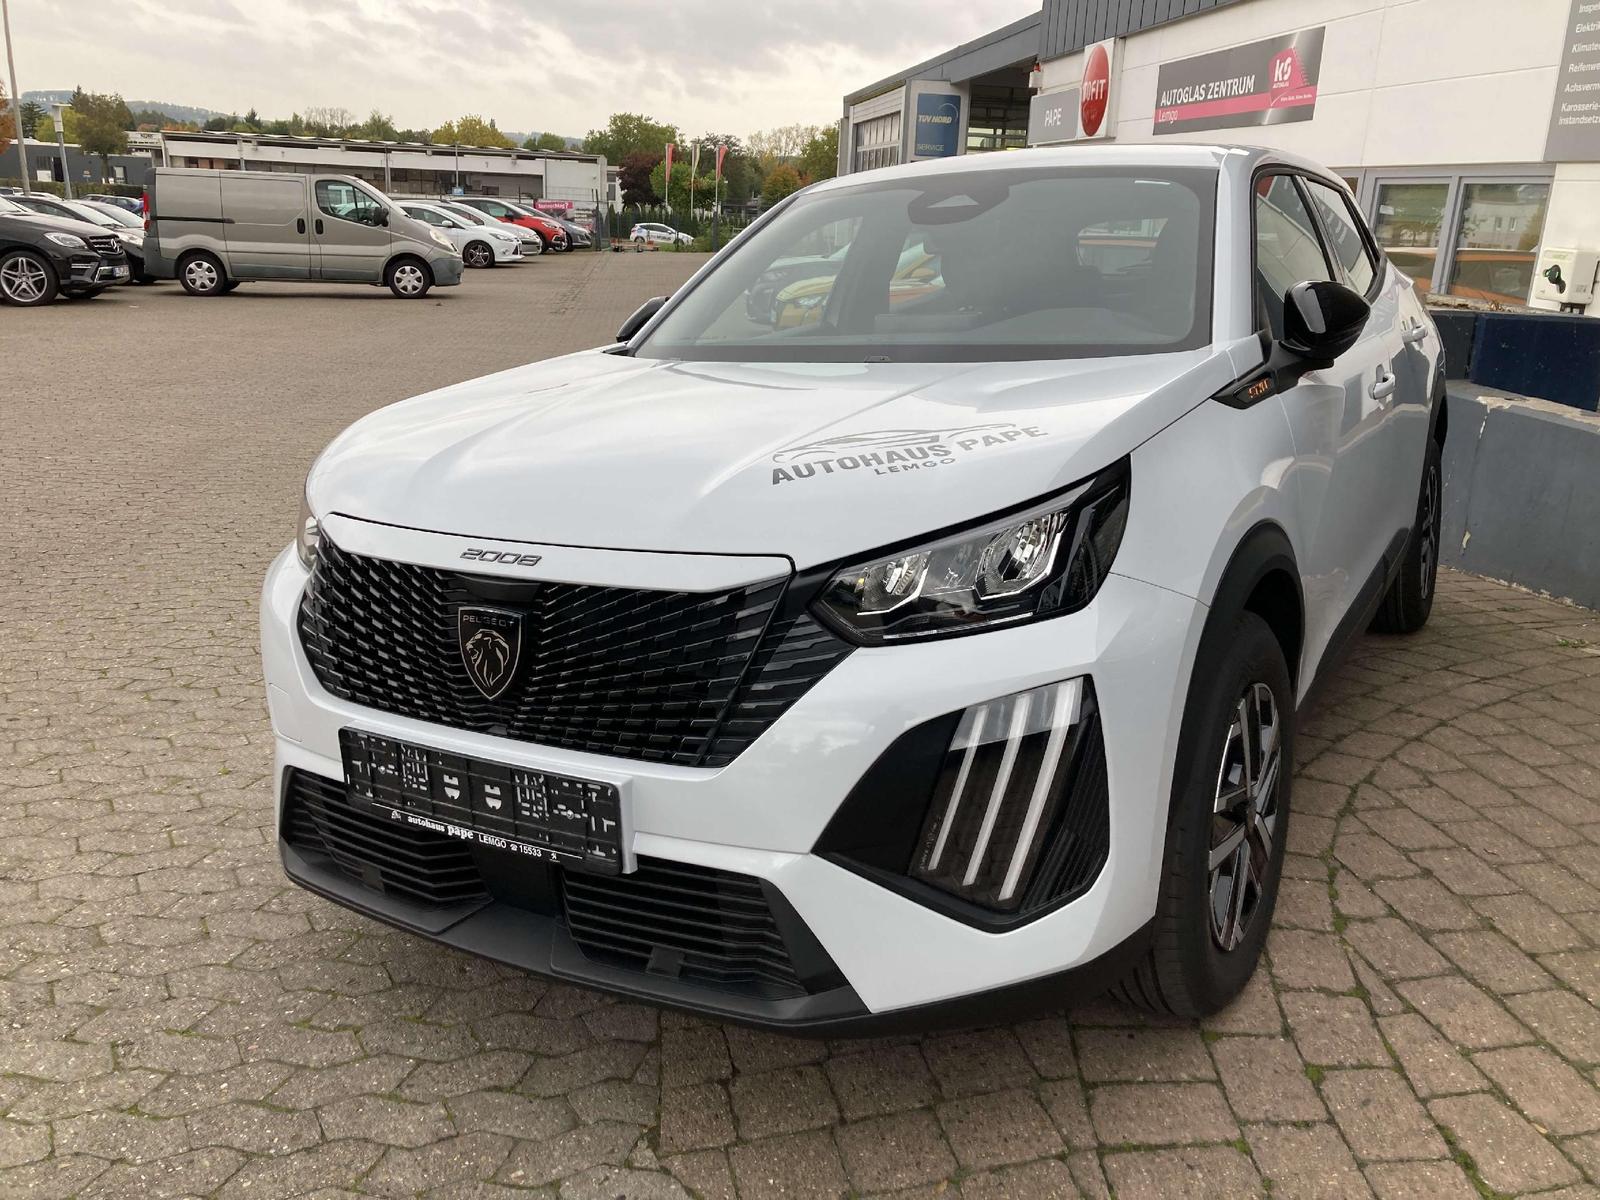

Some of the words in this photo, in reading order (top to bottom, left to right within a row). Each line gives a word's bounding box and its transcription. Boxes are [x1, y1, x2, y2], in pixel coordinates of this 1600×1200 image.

[1160, 83, 1206, 107] AUTOGLAS
[1207, 74, 1256, 100] ZENTRUM
[1564, 82, 1600, 93] Achsverm
[932, 114, 953, 124] NORD
[1044, 108, 1062, 127] PAPE
[1158, 108, 1179, 124] Lemgo
[917, 143, 945, 152] SERVICE
[772, 444, 953, 485] AUTOHAUS
[957, 425, 1049, 451] PAPE
[874, 458, 956, 475] LEMGO
[460, 548, 542, 566] 2008
[407, 815, 445, 832] autohaus
[447, 824, 474, 840] pape
[478, 833, 507, 849] LEMGO
[519, 844, 542, 858] 15533
